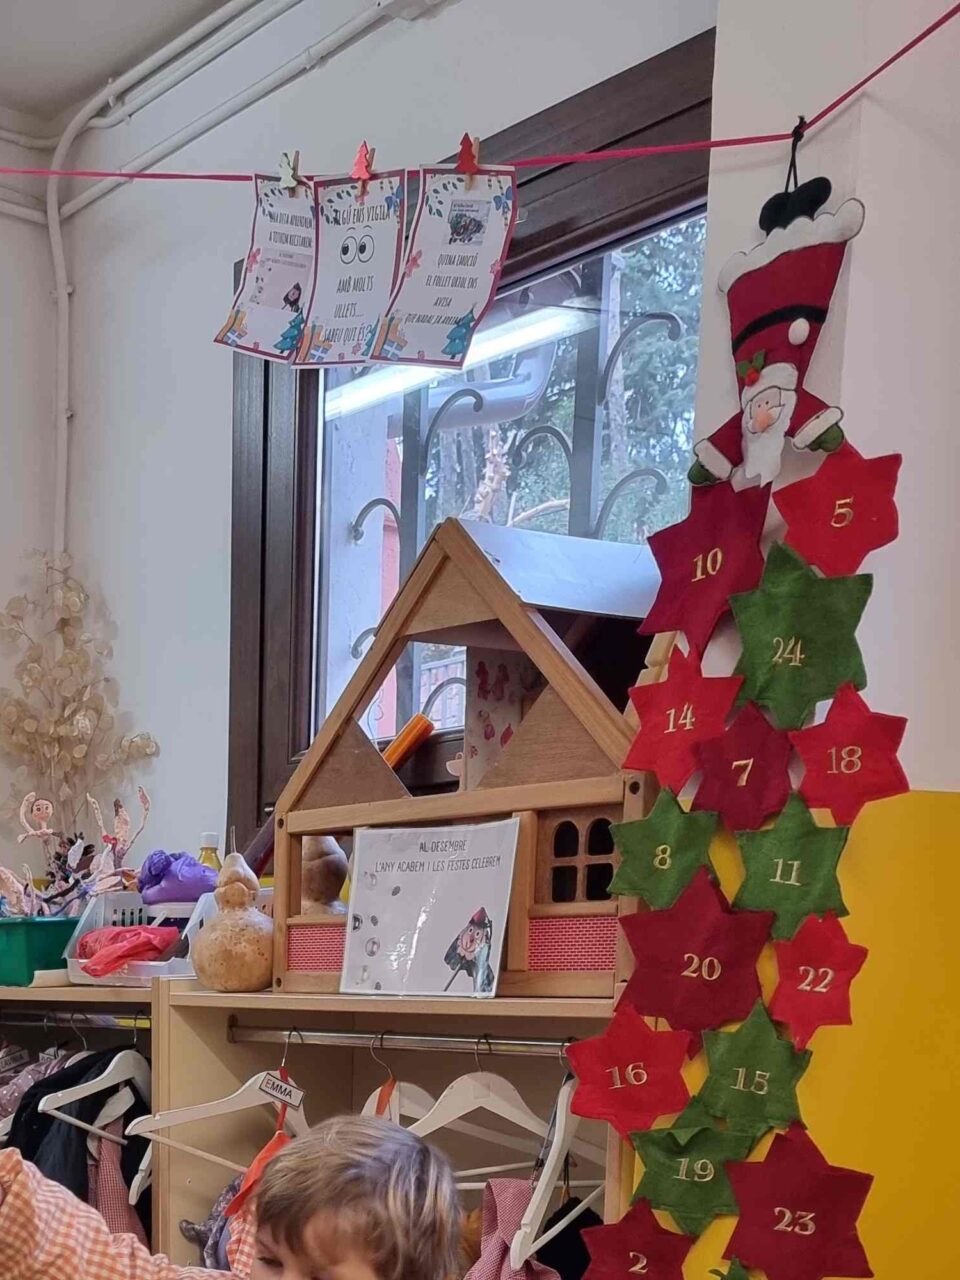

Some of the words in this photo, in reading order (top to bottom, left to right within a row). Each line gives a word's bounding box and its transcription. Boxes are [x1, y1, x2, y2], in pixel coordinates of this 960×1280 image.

[353, 207, 365, 224] ENS
[437, 254, 455, 268] QUINA
[337, 276, 351, 293] AMB
[351, 275, 374, 292] MOLTS
[830, 496, 854, 528] 5
[691, 547, 723, 582] 10
[772, 636, 805, 667] 24
[663, 702, 696, 734] 14
[732, 757, 754, 786] 7
[826, 745, 862, 775] 18
[419, 841, 429, 853] AL
[431, 839, 467, 853] DESEMBRE
[653, 844, 672, 870] 8
[375, 861, 395, 873] L'ANY
[397, 860, 425, 873] ACABEM
[432, 860, 445, 872] LES
[447, 858, 470, 872] FESTES
[471, 855, 501, 870] CELEBREM
[769, 858, 802, 886] 11
[681, 953, 722, 981] 20
[796, 966, 835, 992] 22
[265, 1078, 293, 1100] EMMA
[605, 1062, 648, 1089] 16
[730, 1067, 771, 1095] 15
[673, 1157, 715, 1182] 19
[773, 1206, 816, 1236] 23
[629, 1251, 648, 1275] 2
